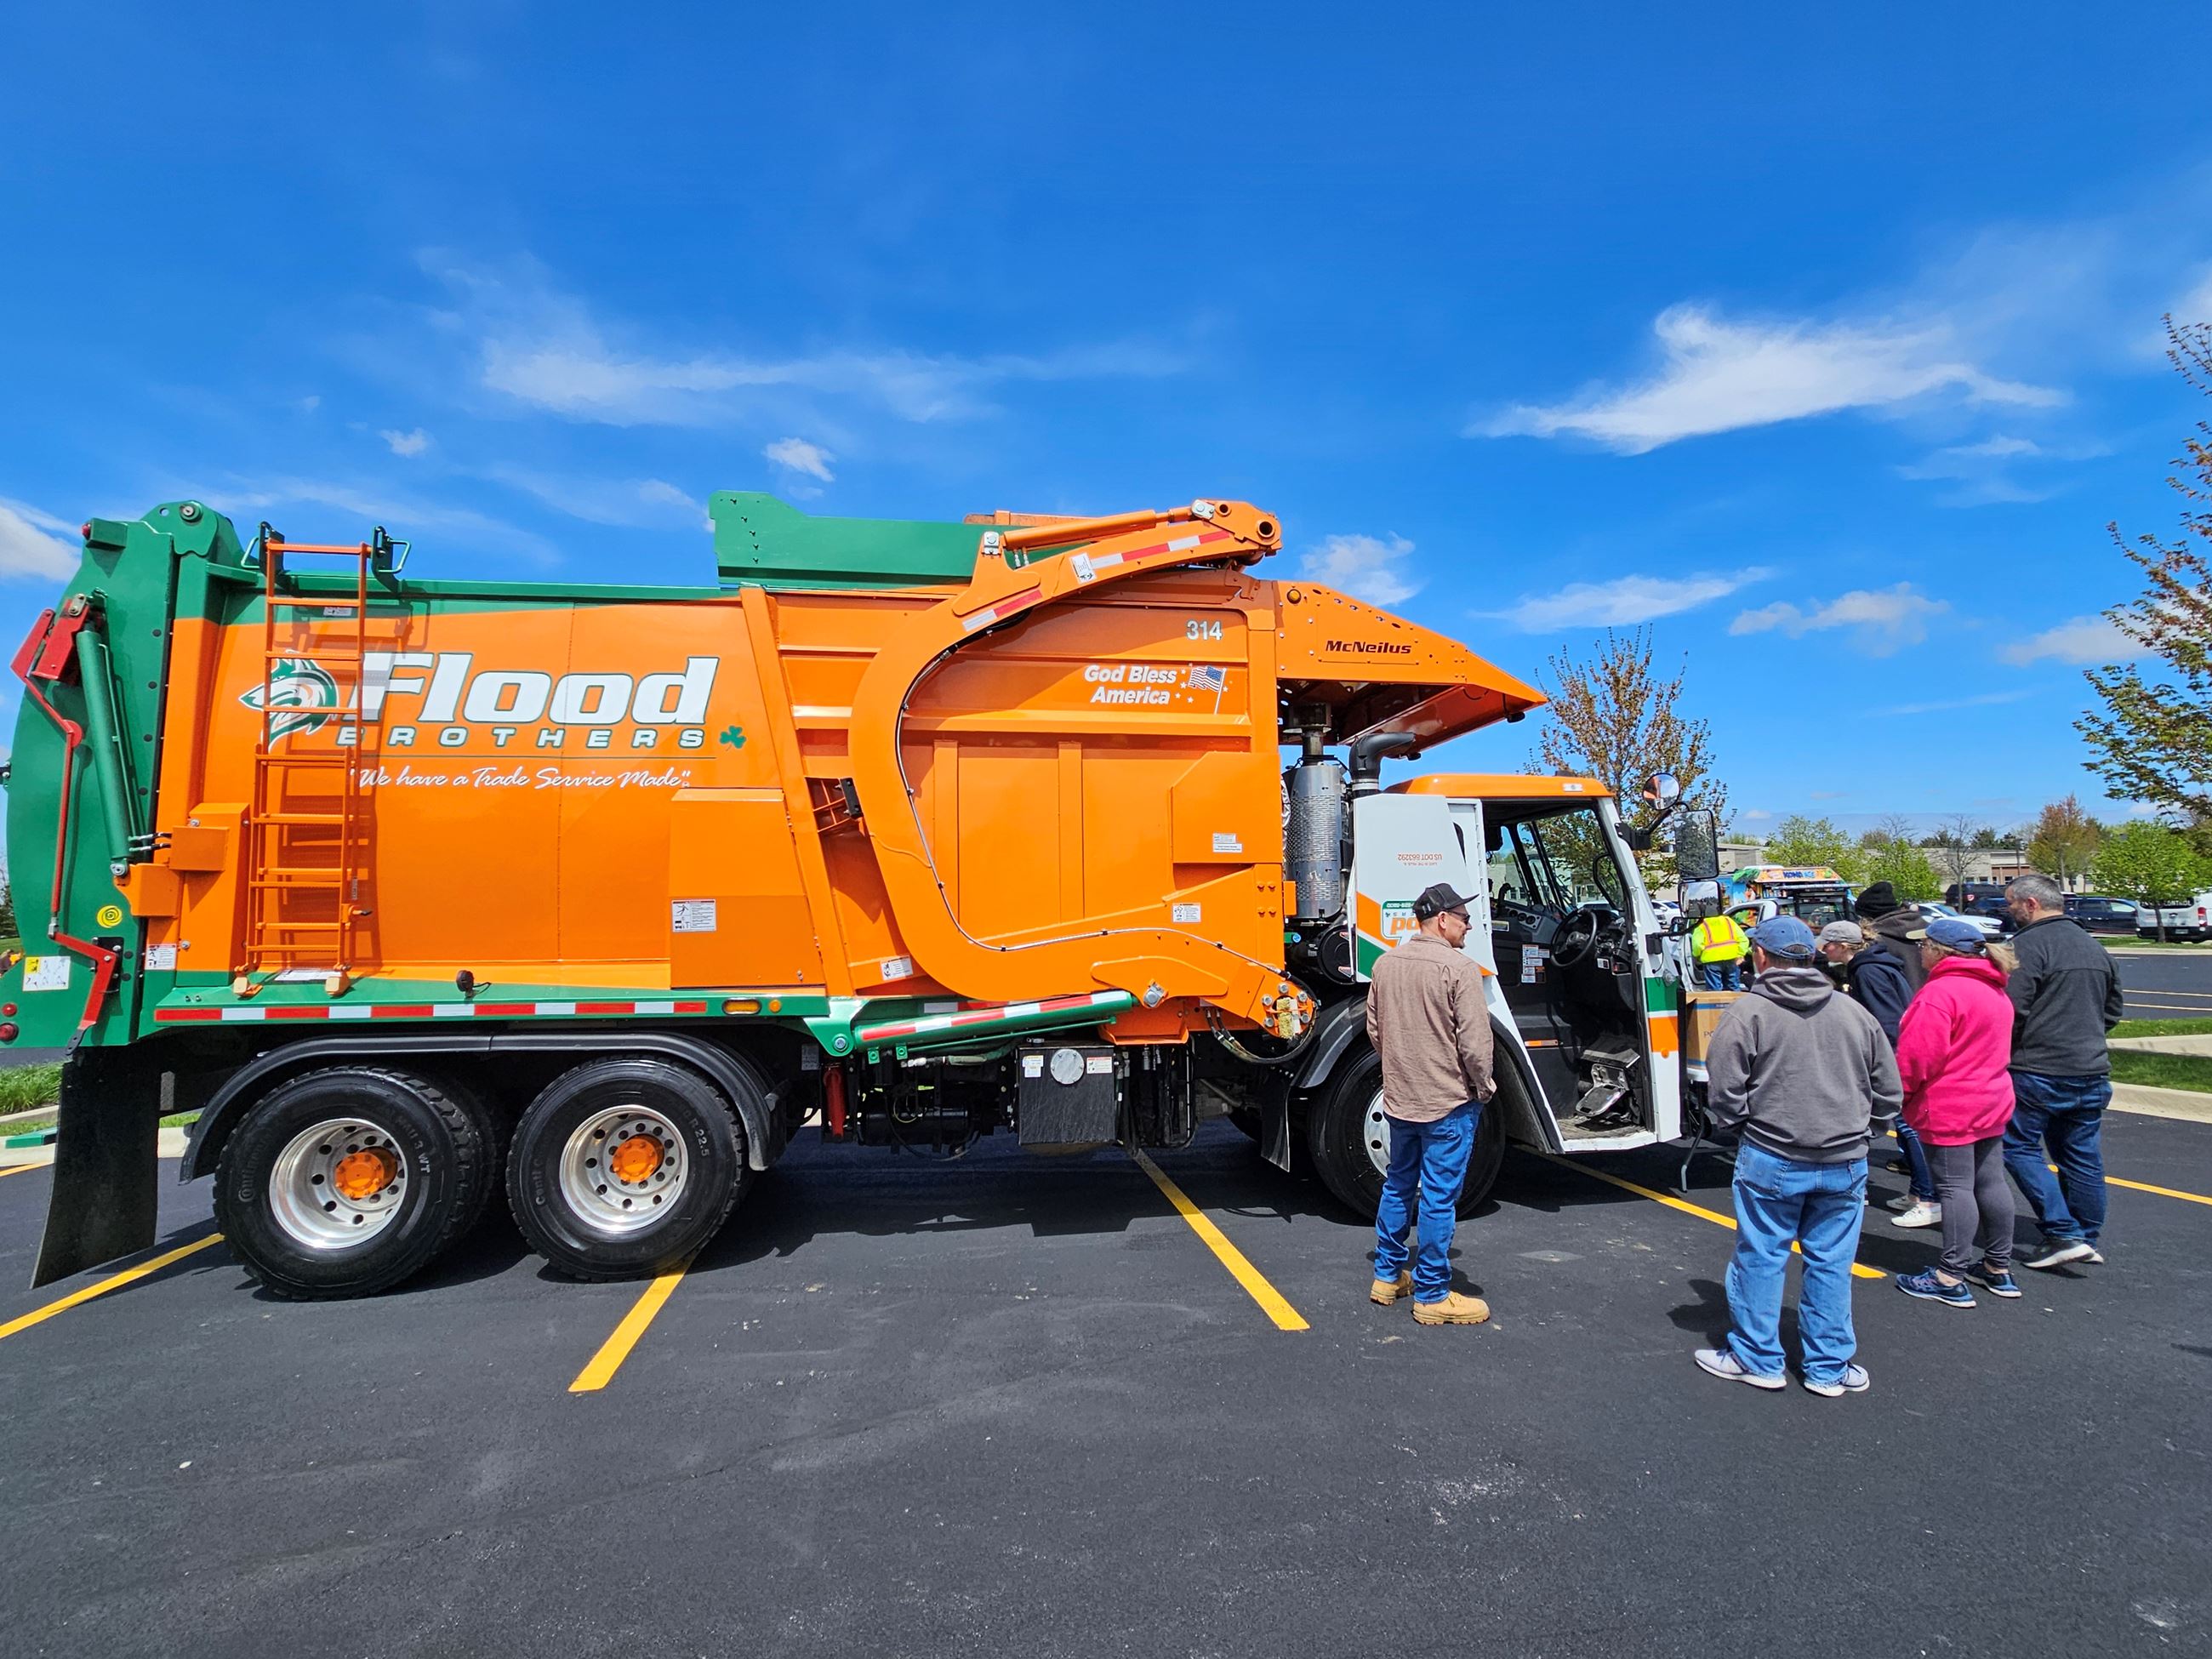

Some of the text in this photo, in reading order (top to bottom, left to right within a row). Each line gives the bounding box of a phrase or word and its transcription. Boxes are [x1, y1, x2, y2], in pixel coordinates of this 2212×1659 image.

[1186, 619, 1223, 641] 314
[1325, 640, 1411, 654] McNeilus
[1084, 664, 1177, 684] God Bless
[342, 651, 720, 725] Flood
[1090, 686, 1171, 705] America
[335, 727, 705, 749] BROTHERS
[396, 766, 448, 787] have
[453, 773, 469, 786] a
[472, 767, 530, 788] Trade
[534, 767, 615, 790] Service
[694, 1128, 710, 1157] 22.5
